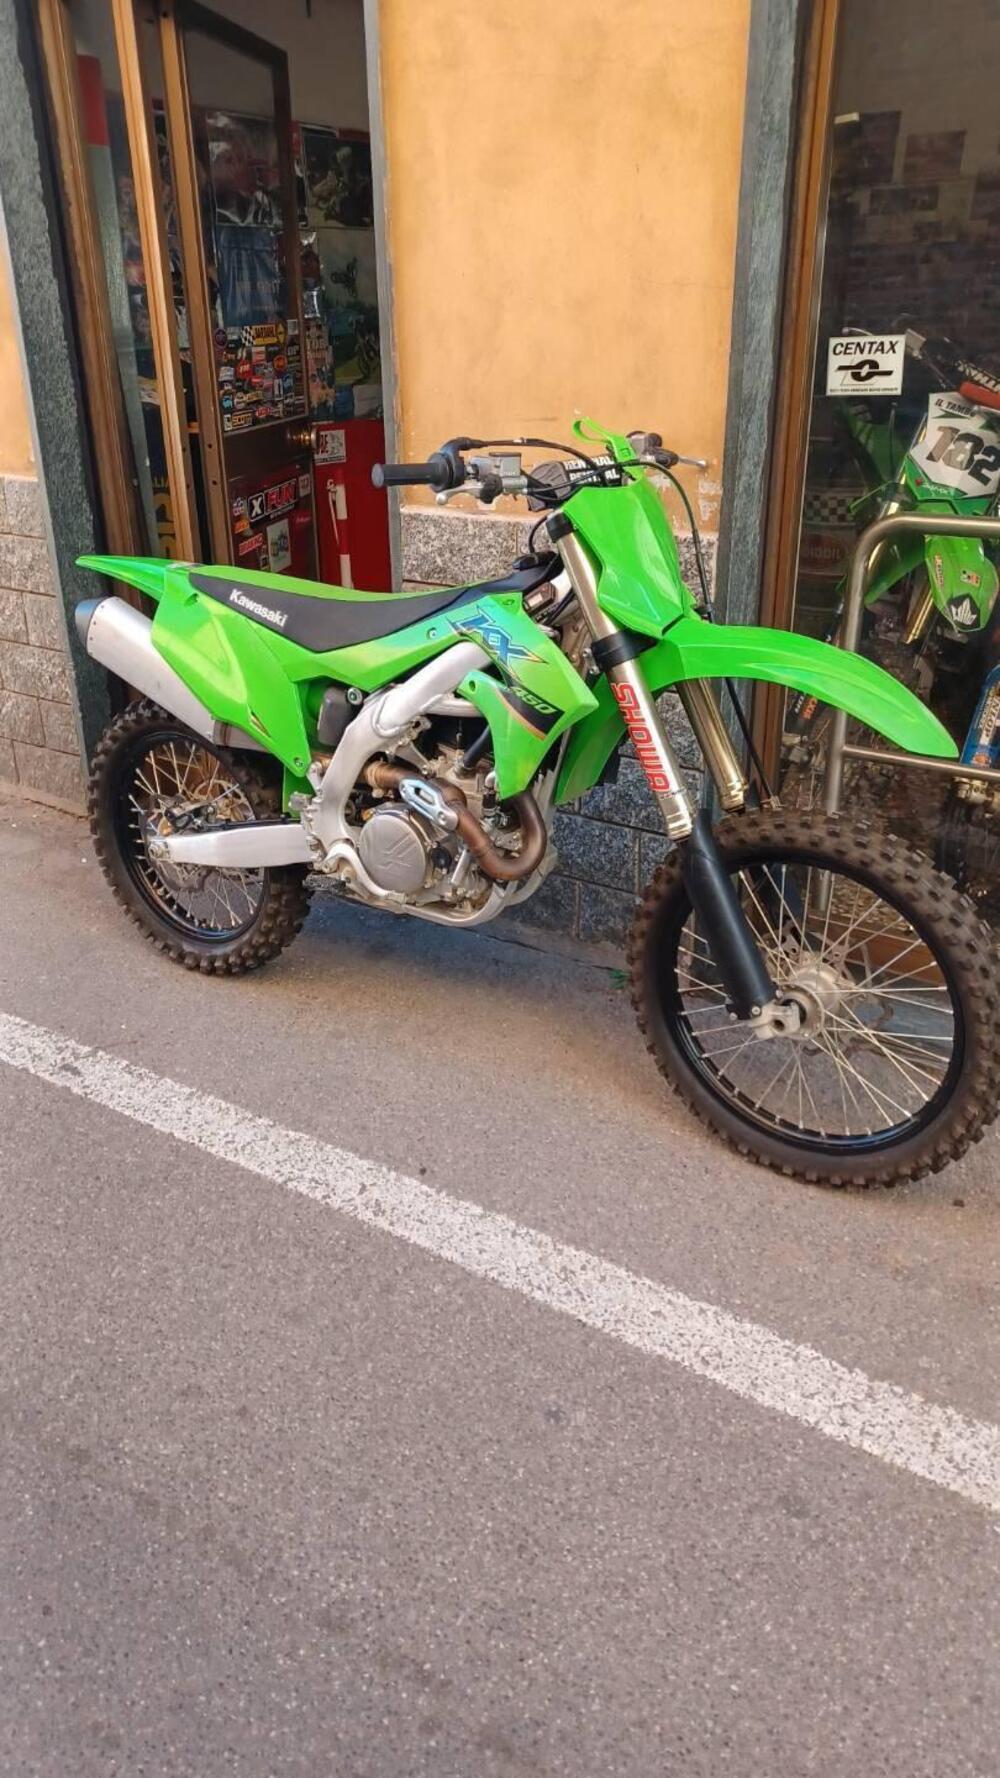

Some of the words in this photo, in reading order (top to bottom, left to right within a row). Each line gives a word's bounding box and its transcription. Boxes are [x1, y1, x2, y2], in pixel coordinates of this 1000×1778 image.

[832, 340, 899, 356] CENTAX
[935, 398, 944, 407] IL
[926, 426, 1000, 486] 182
[251, 496, 262, 518] X
[267, 482, 296, 513] FUN
[229, 588, 288, 627] Kawasaki
[510, 686, 558, 714] 450
[610, 682, 671, 792] SHOWA
